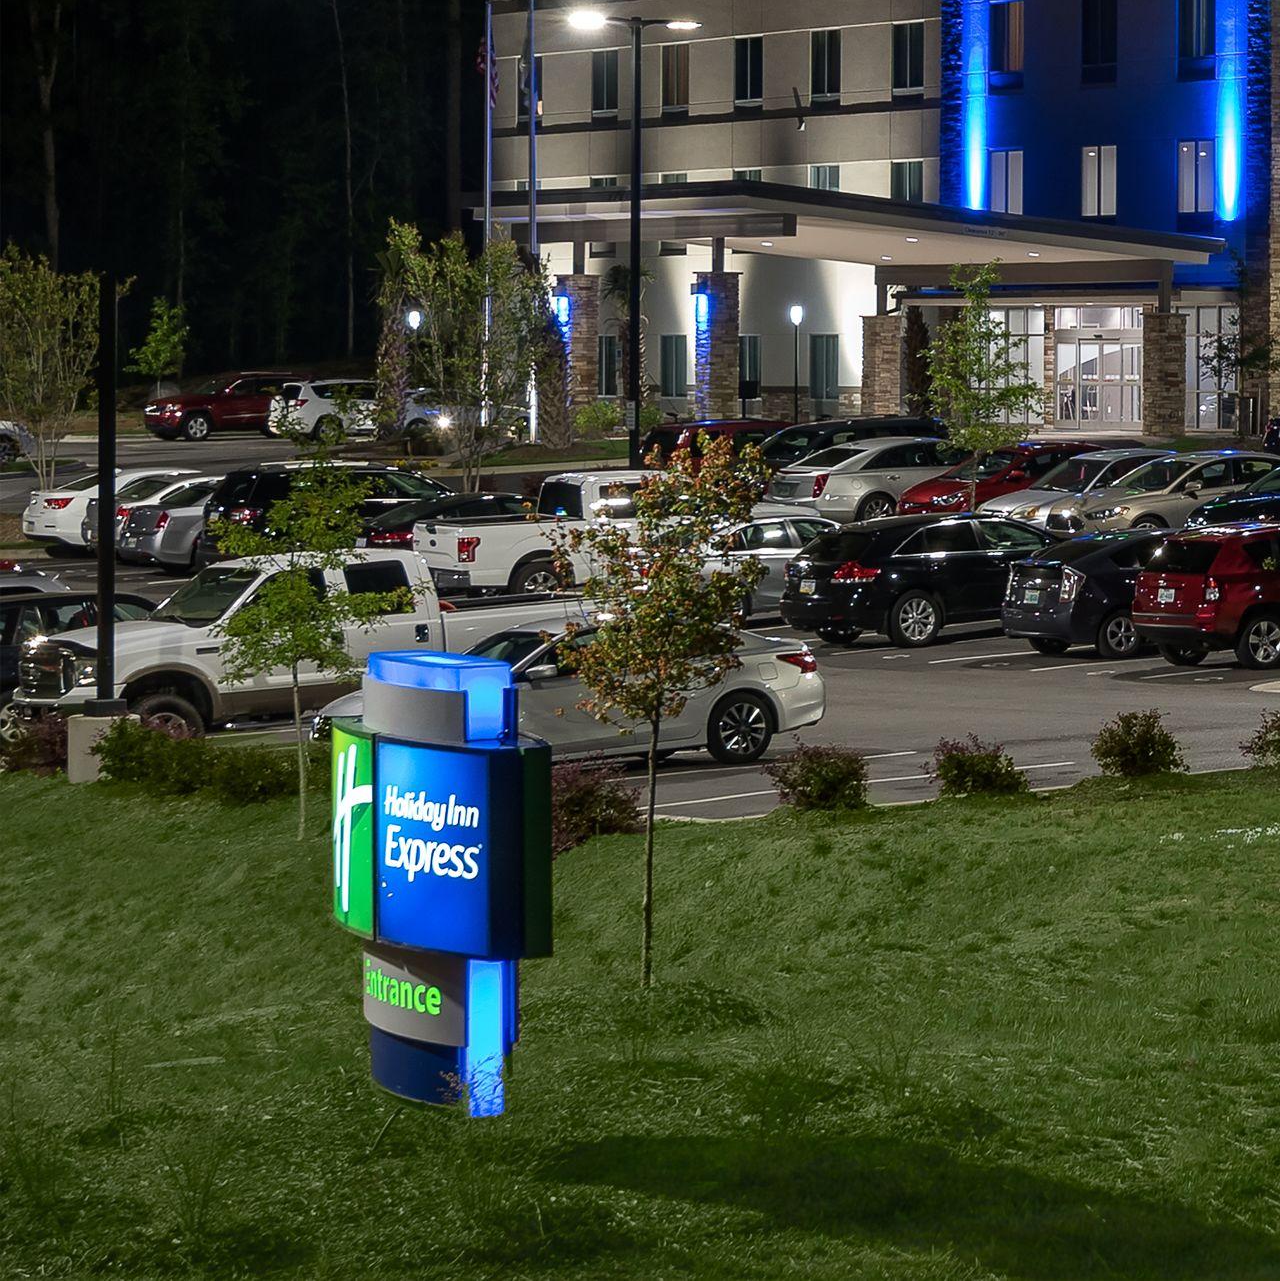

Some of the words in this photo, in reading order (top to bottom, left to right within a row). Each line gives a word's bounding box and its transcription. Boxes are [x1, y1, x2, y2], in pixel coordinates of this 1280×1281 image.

[384, 784, 446, 833] Holiday
[448, 793, 480, 829] Inn
[385, 825, 480, 883] Express
